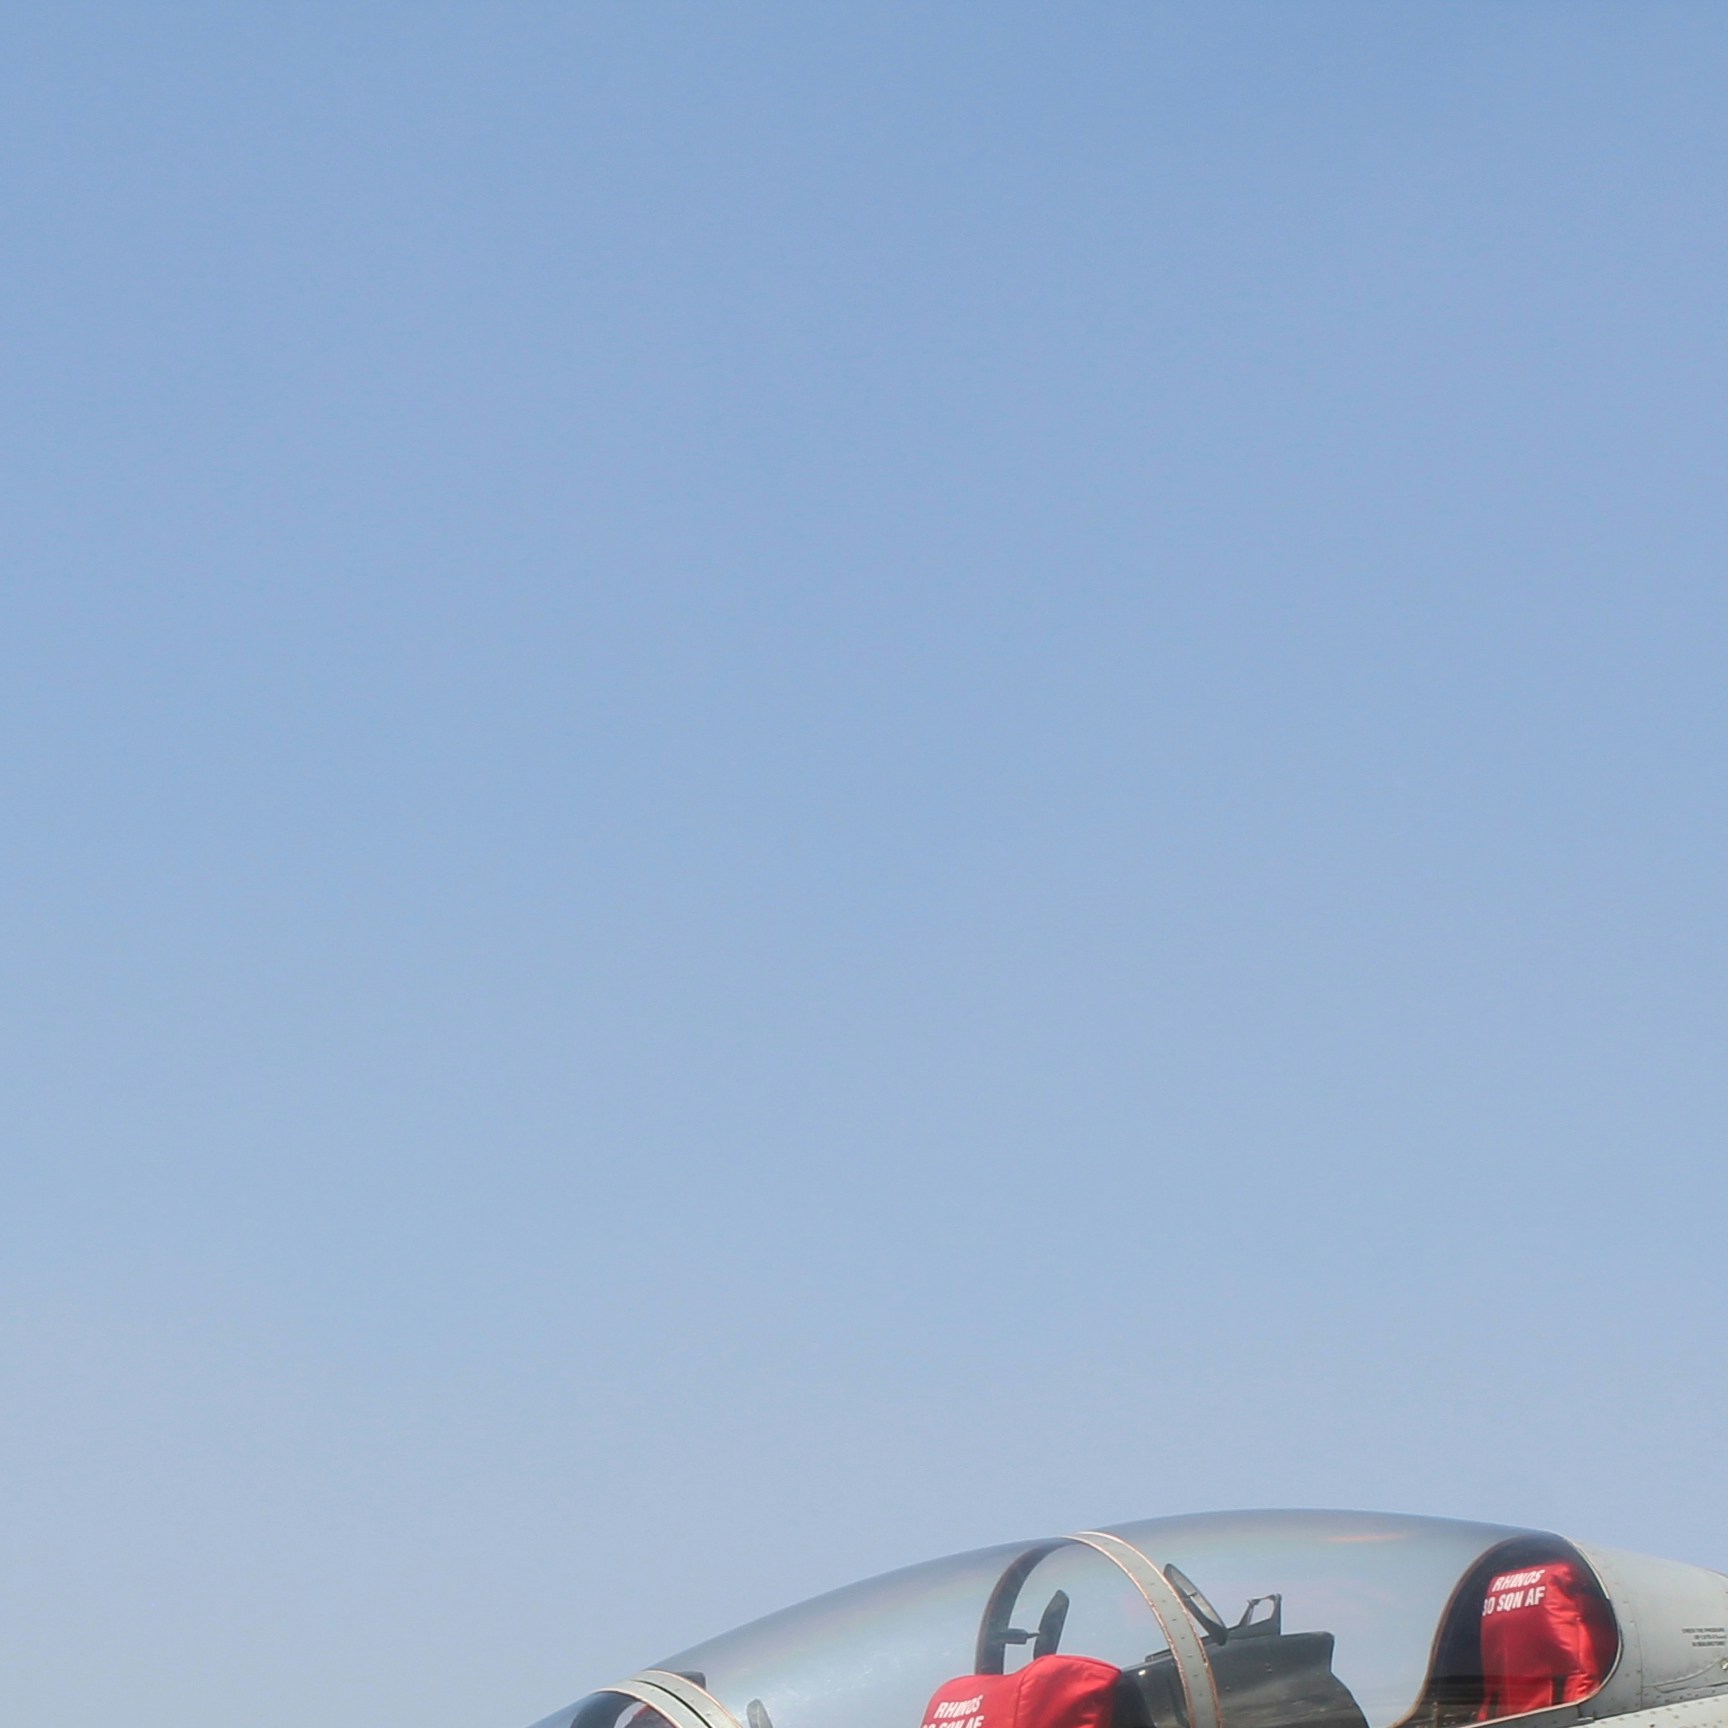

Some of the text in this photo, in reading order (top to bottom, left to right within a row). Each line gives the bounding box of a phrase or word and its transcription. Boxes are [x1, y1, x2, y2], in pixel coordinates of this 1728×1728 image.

[1491, 1569, 1546, 1592] RHINOS
[1496, 1590, 1525, 1612] SQN
[1524, 1586, 1546, 1607] AF
[933, 1694, 984, 1719] RHINOS
